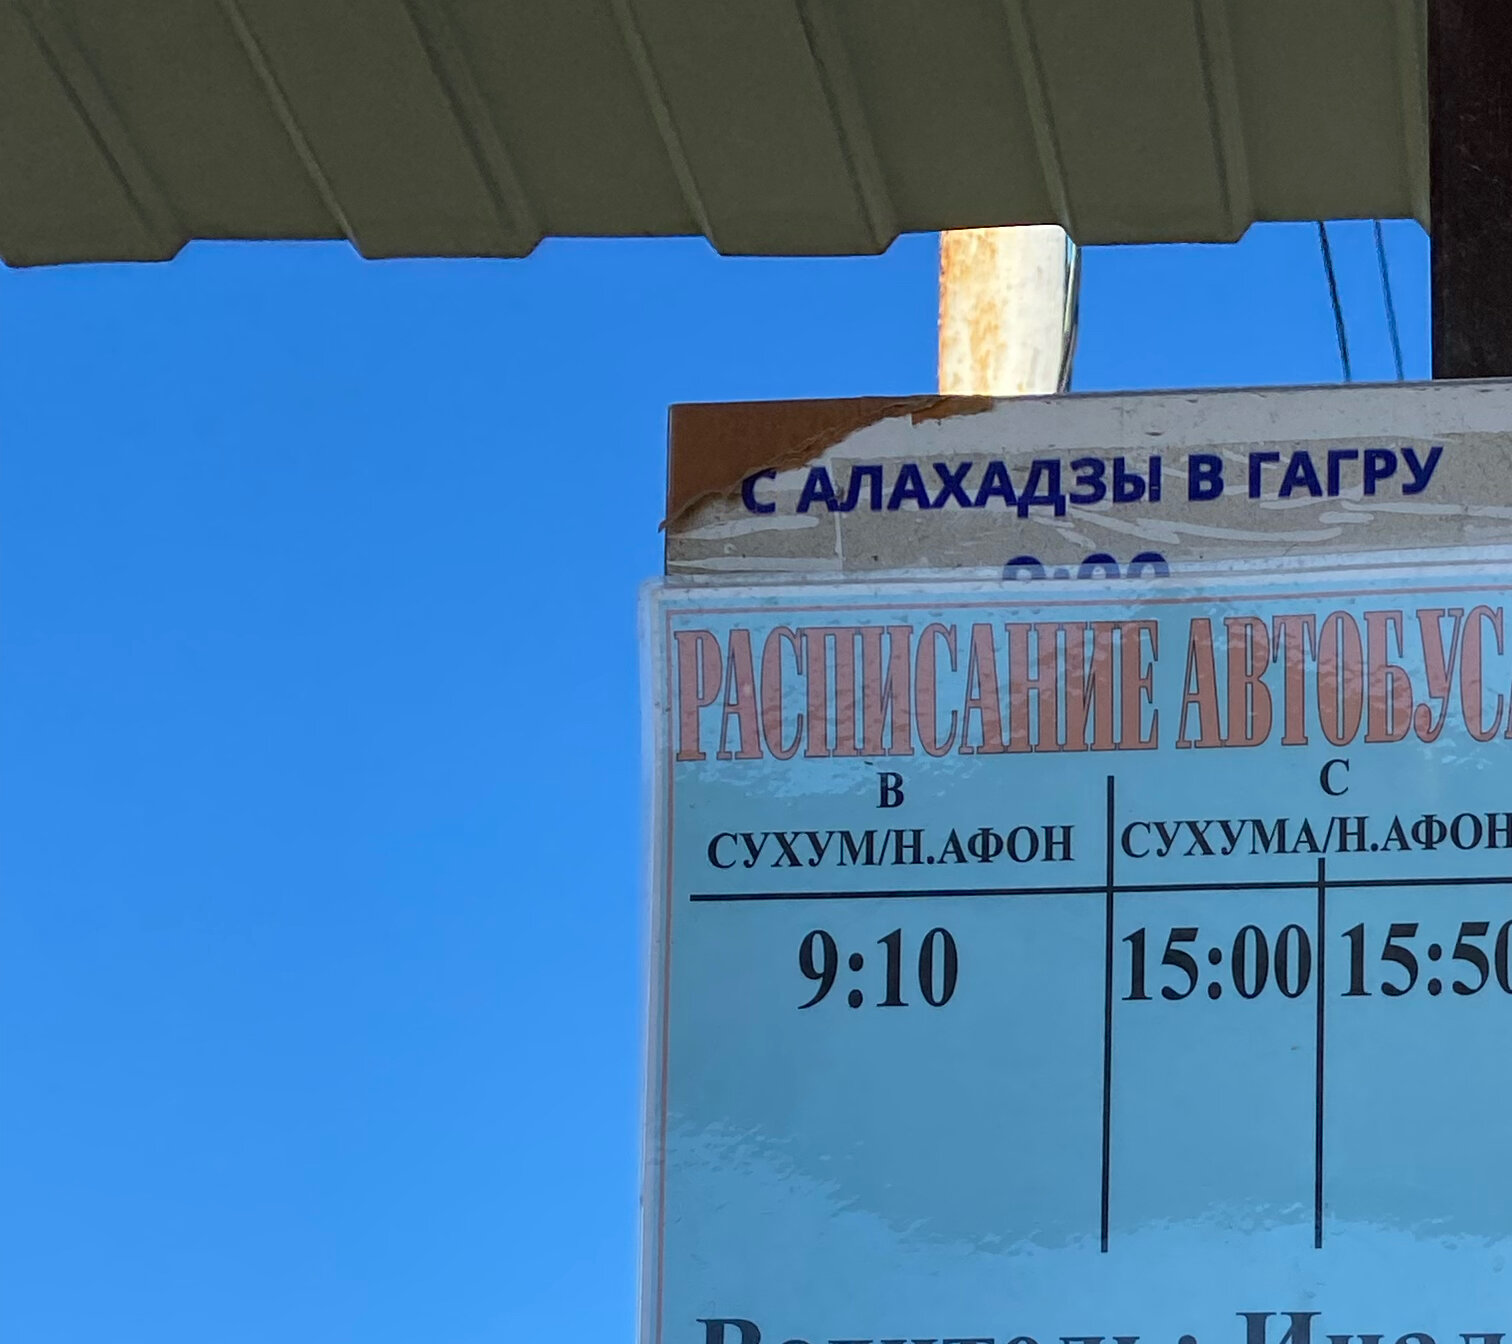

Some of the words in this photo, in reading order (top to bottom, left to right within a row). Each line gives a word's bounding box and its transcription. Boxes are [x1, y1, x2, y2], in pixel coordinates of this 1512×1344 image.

[741, 467, 777, 514] С
[797, 456, 1162, 517] АЛАХАДЗЫ
[1188, 455, 1223, 501] В
[1249, 447, 1443, 498] ГАГРУ
[674, 619, 1160, 762] РАСПИСАНИЕ
[877, 773, 904, 808] В
[1320, 759, 1349, 795] С
[708, 826, 1074, 868] СУХУМ/Н.АФОН
[798, 928, 957, 1009] 9:10
[1122, 925, 1311, 1000] 15:00
